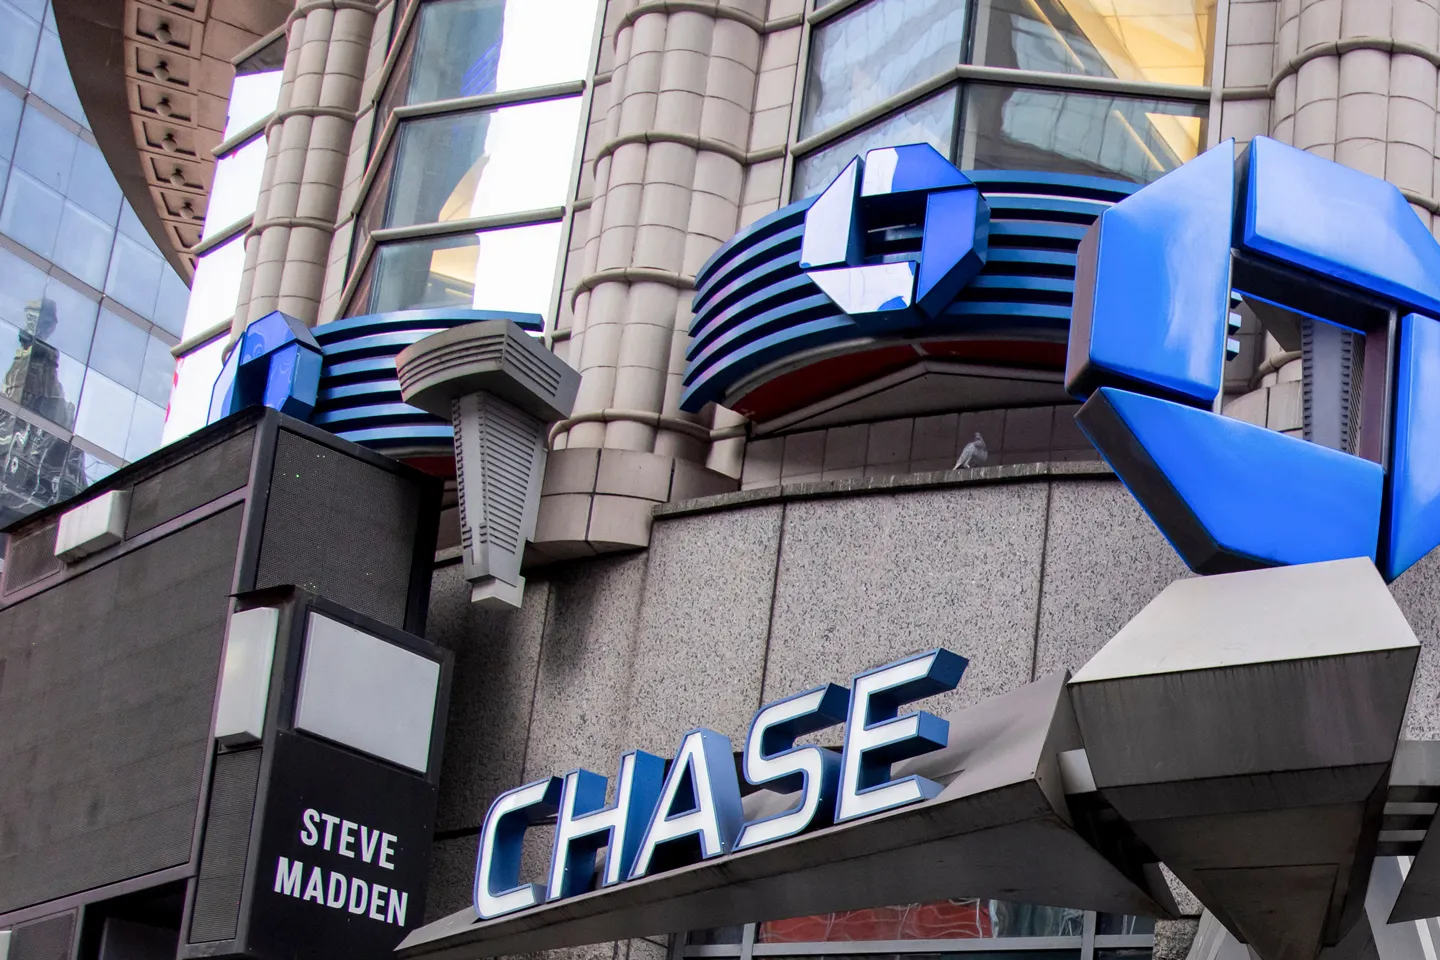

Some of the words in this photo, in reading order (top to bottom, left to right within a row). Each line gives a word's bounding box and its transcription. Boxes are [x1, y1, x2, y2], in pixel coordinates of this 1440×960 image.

[474, 647, 970, 920] CHASE
[300, 807, 398, 871] STEVE
[273, 855, 409, 927] MADDEN
